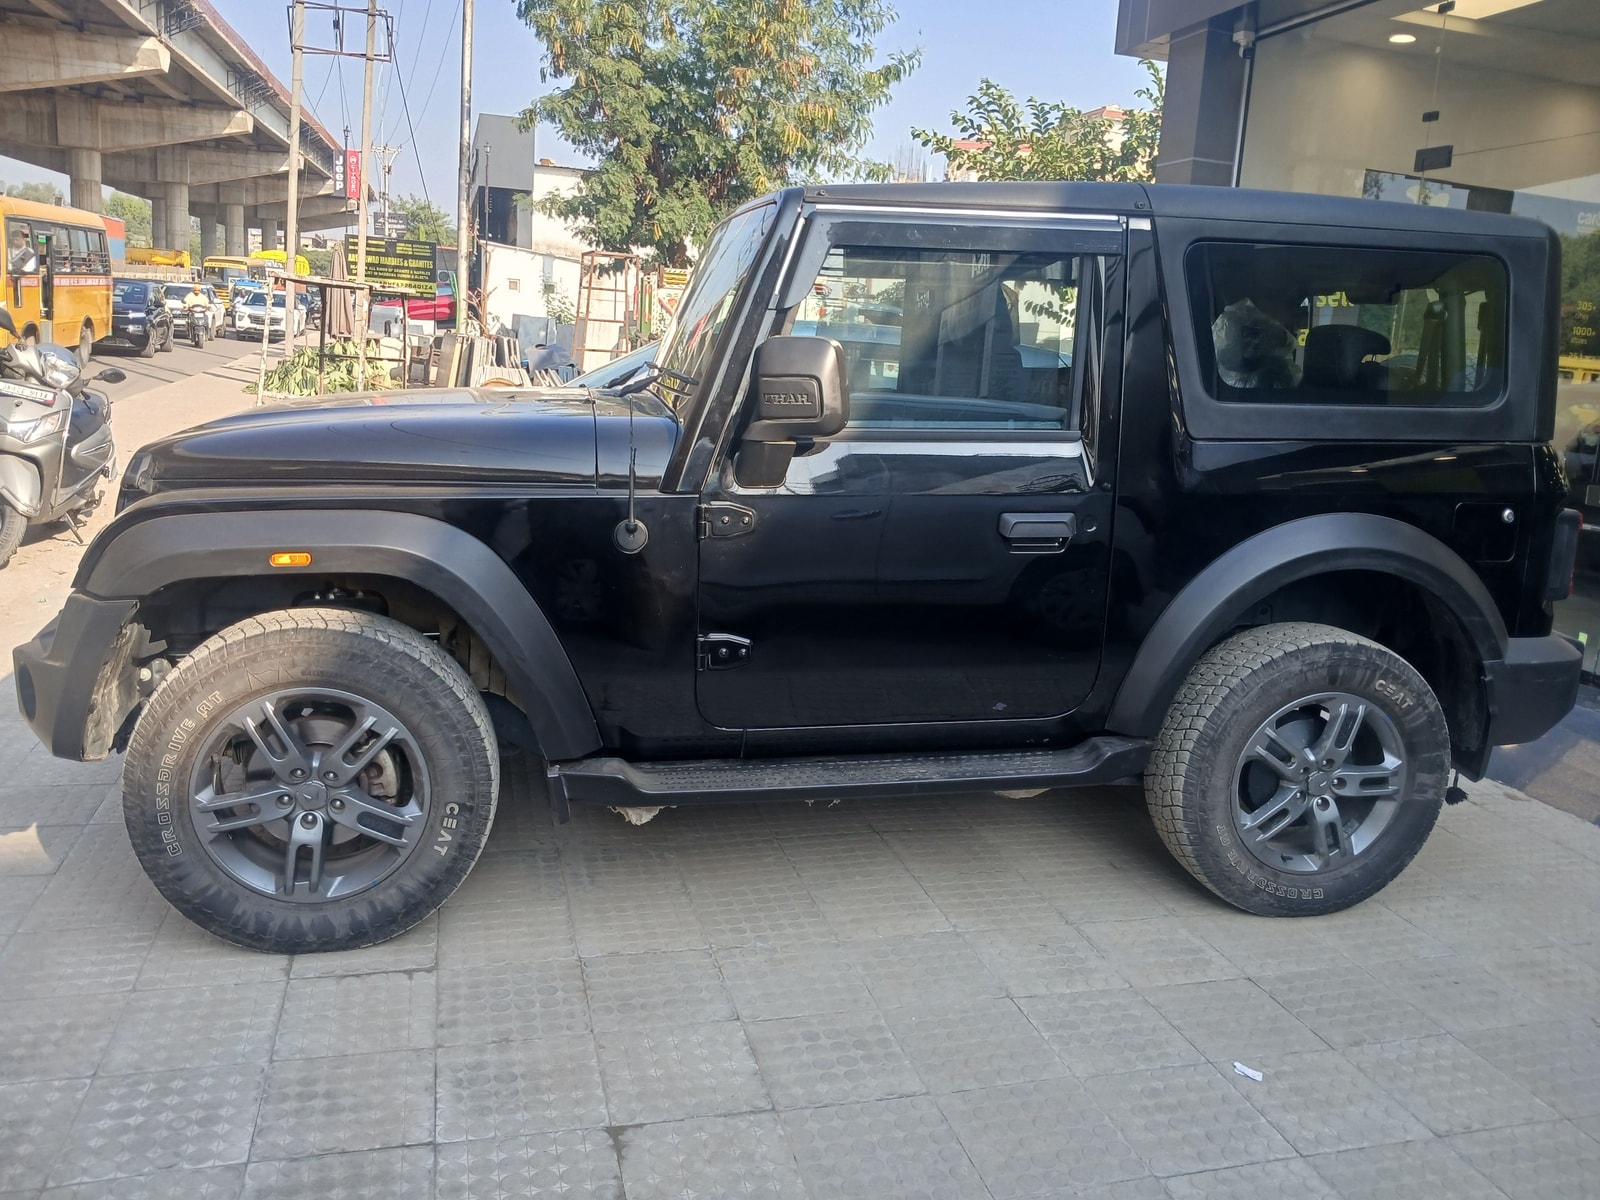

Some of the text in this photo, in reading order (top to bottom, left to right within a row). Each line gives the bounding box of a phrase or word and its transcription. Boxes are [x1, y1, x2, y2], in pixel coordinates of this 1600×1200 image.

[335, 155, 344, 191] Jeep
[763, 393, 813, 405] THAR
[1375, 679, 1413, 709] CEAT
[156, 690, 224, 857] CROSSDRIVE AT
[433, 802, 460, 856] CEAT
